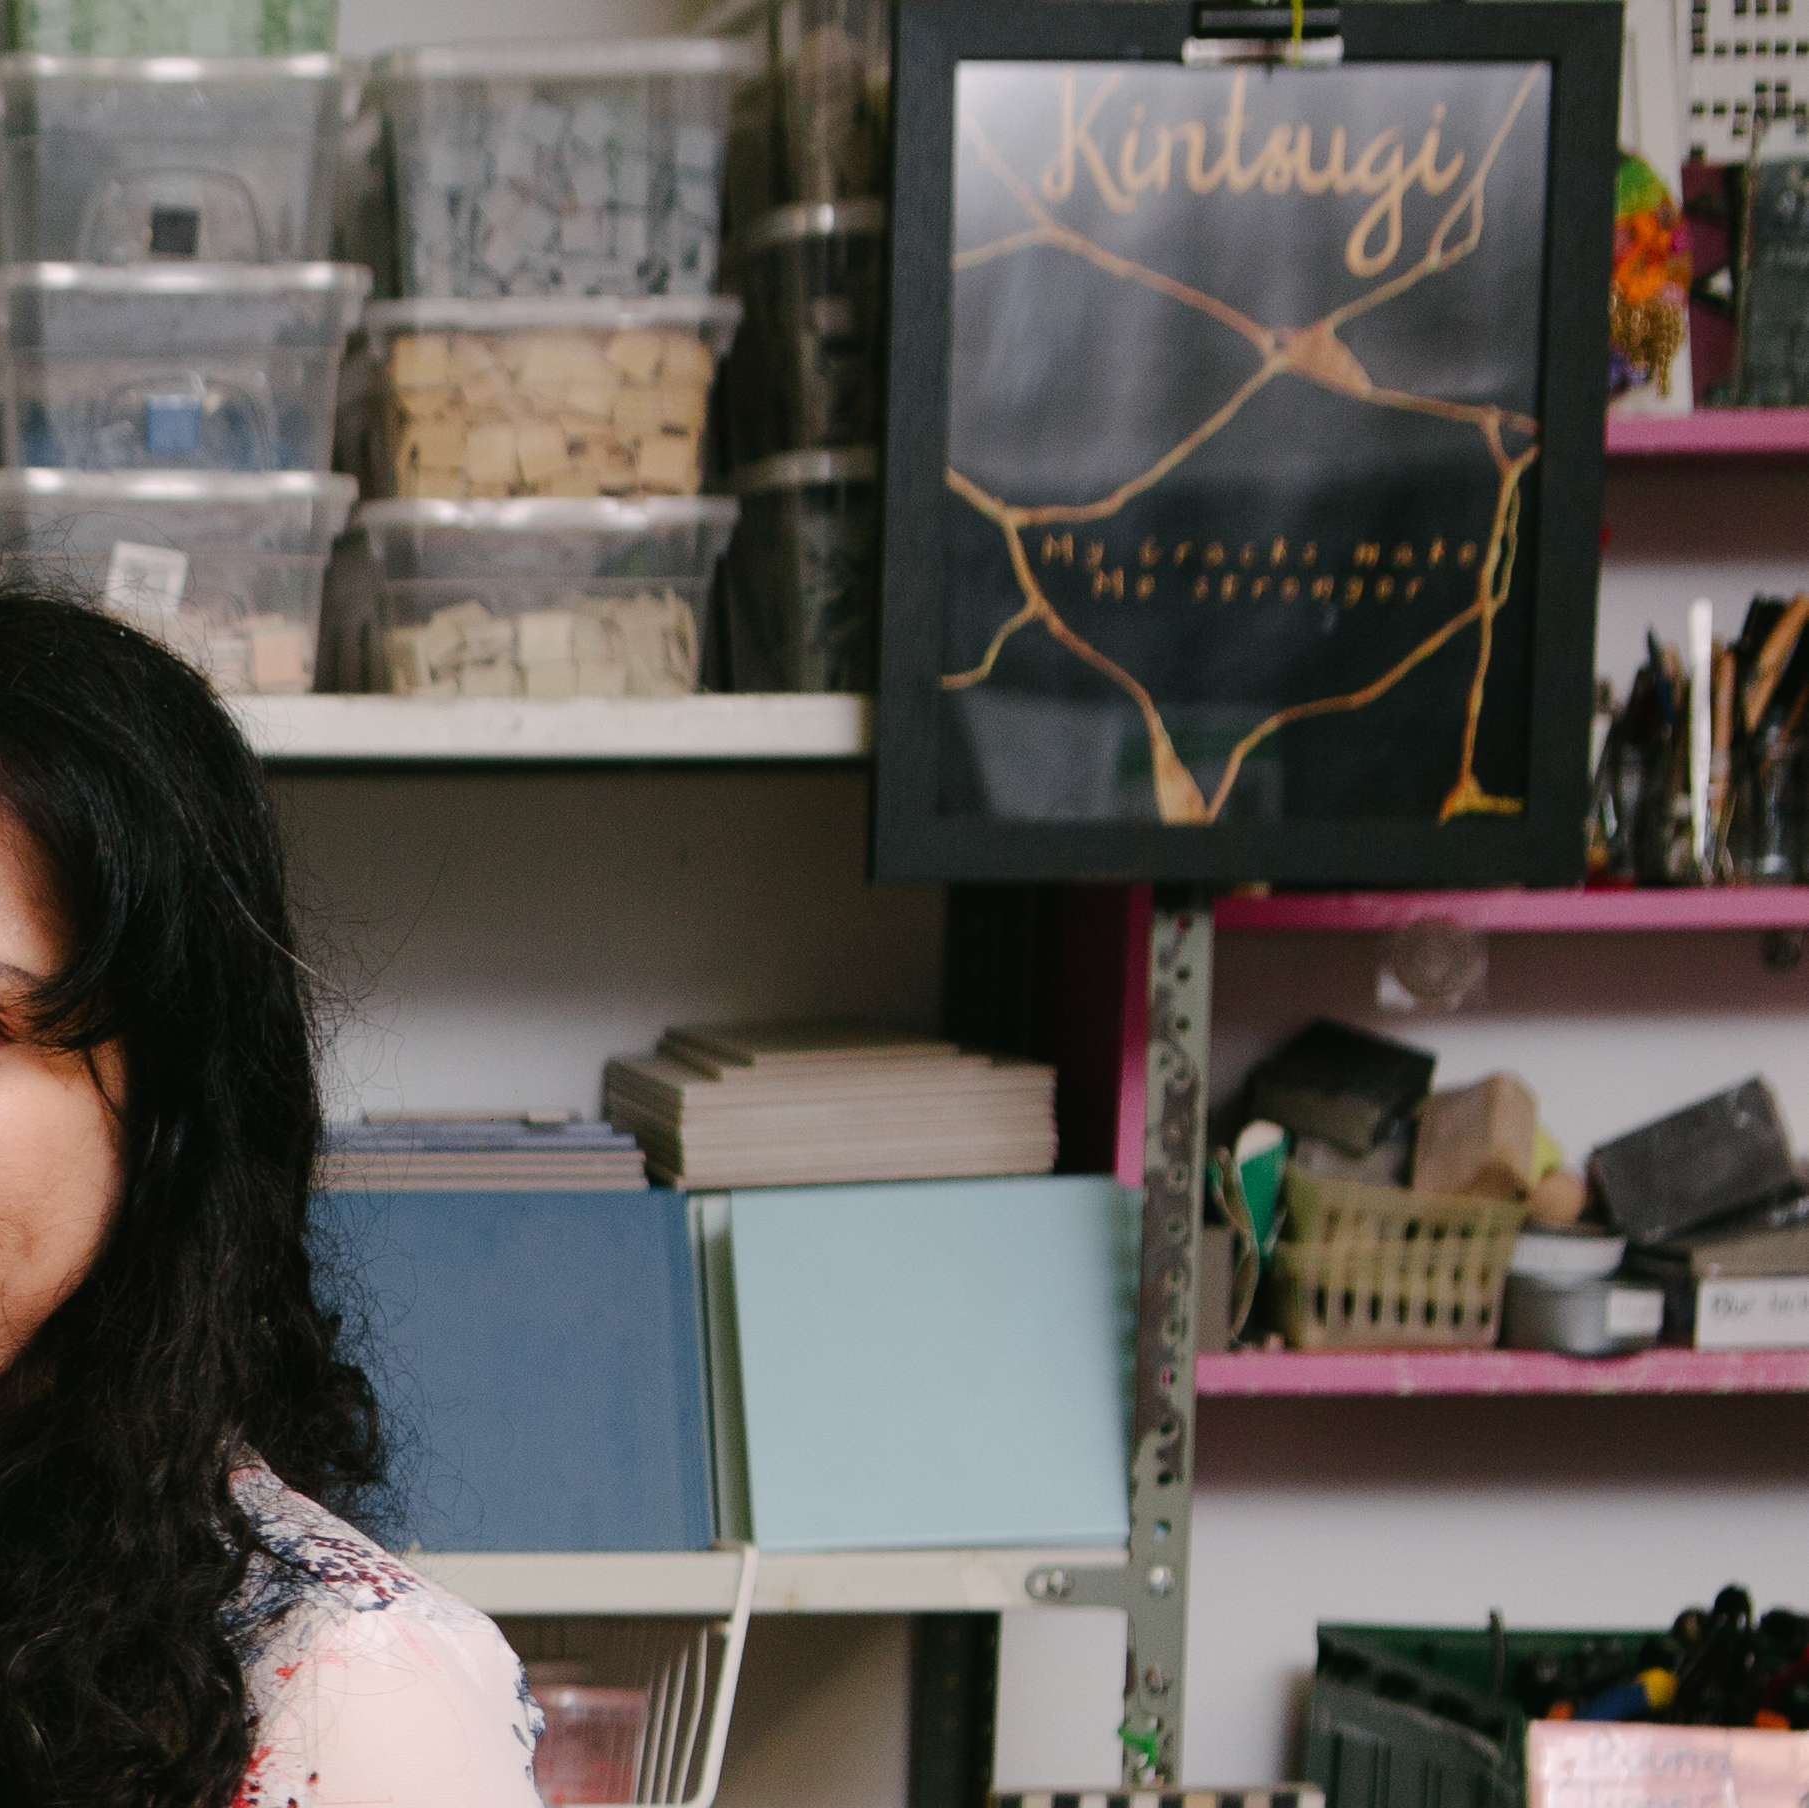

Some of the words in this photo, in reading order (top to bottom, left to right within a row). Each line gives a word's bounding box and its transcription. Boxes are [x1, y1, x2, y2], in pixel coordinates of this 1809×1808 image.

[1041, 71, 1465, 278] Kintsugi
[1040, 533, 1104, 572] My
[1352, 537, 1478, 567] make
[1091, 567, 1155, 601] Me
[1193, 574, 1425, 609] stronger
